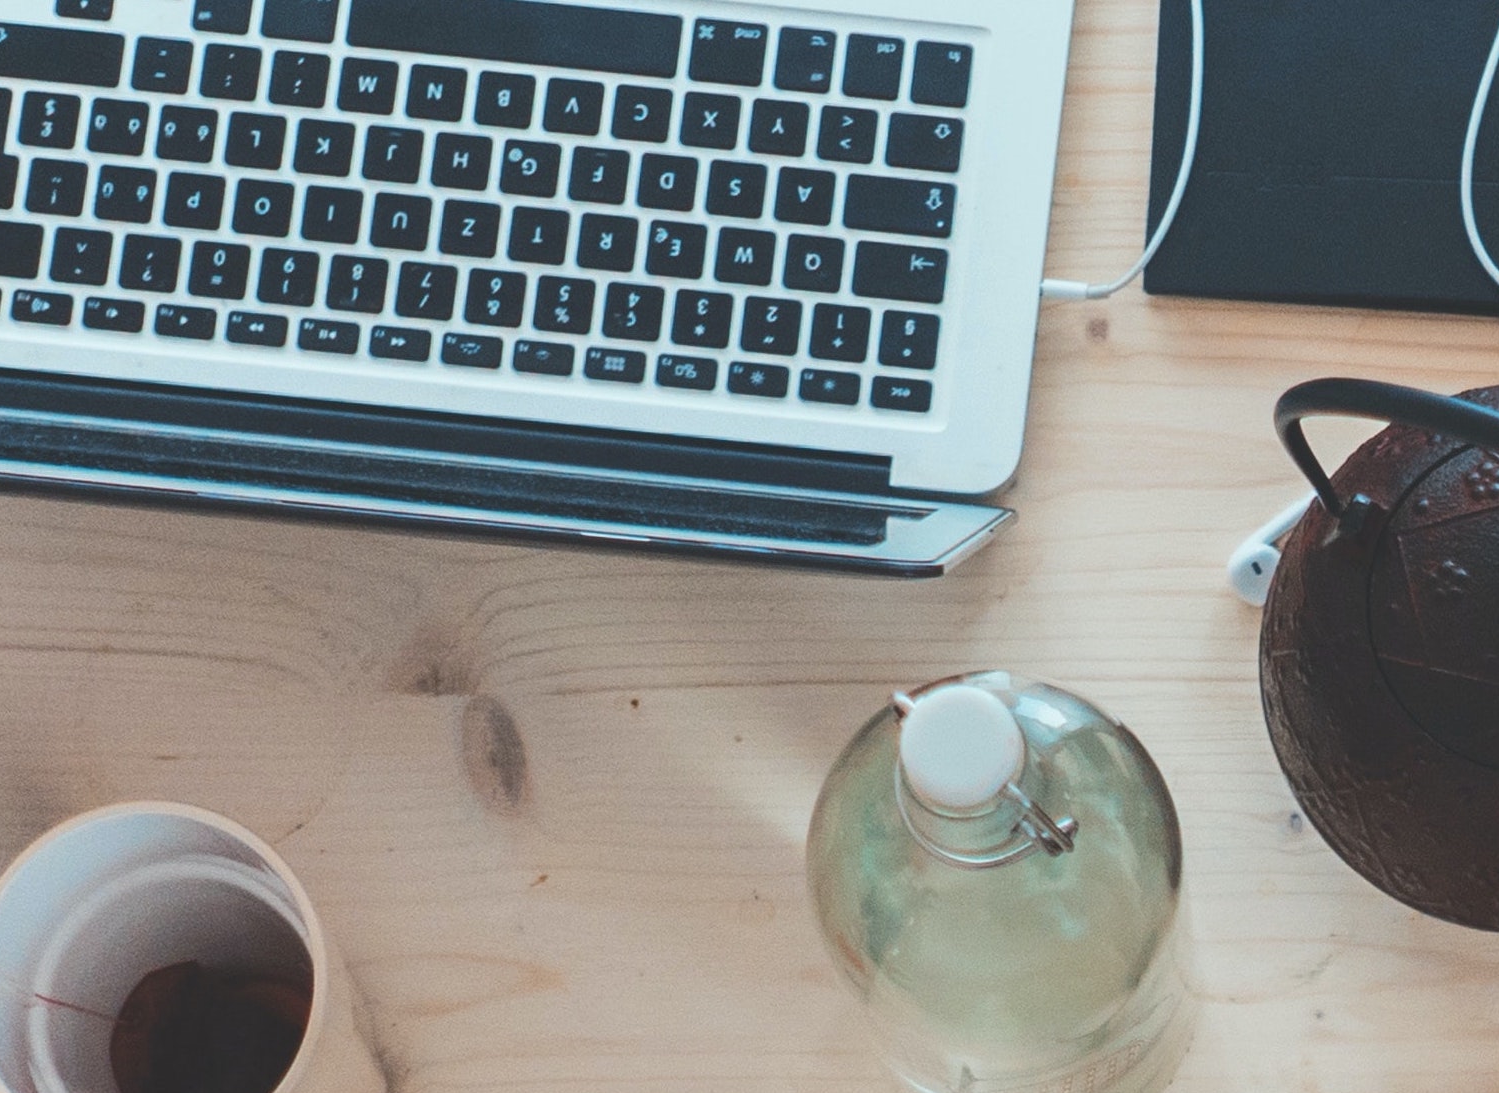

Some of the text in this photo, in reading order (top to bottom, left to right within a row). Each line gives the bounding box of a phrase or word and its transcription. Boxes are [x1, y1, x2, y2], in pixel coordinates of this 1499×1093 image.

[357, 74, 786, 135] Y X C V B N M
[249, 128, 814, 204] A S D F G H J K L
[185, 190, 202, 210] P
[253, 195, 272, 216] O
[390, 210, 409, 231] U
[460, 216, 477, 238] Z
[530, 225, 544, 245] T
[598, 231, 614, 251] R
[668, 237, 683, 258] E
[733, 245, 755, 265] W
[282, 256, 297, 275] 9
[803, 251, 823, 272] Q
[350, 263, 365, 282] 8
[419, 270, 433, 289] 7
[489, 276, 504, 295] 6
[558, 284, 572, 303] 5
[627, 291, 641, 309] 4
[696, 297, 710, 317] 3
[764, 304, 779, 324] 2
